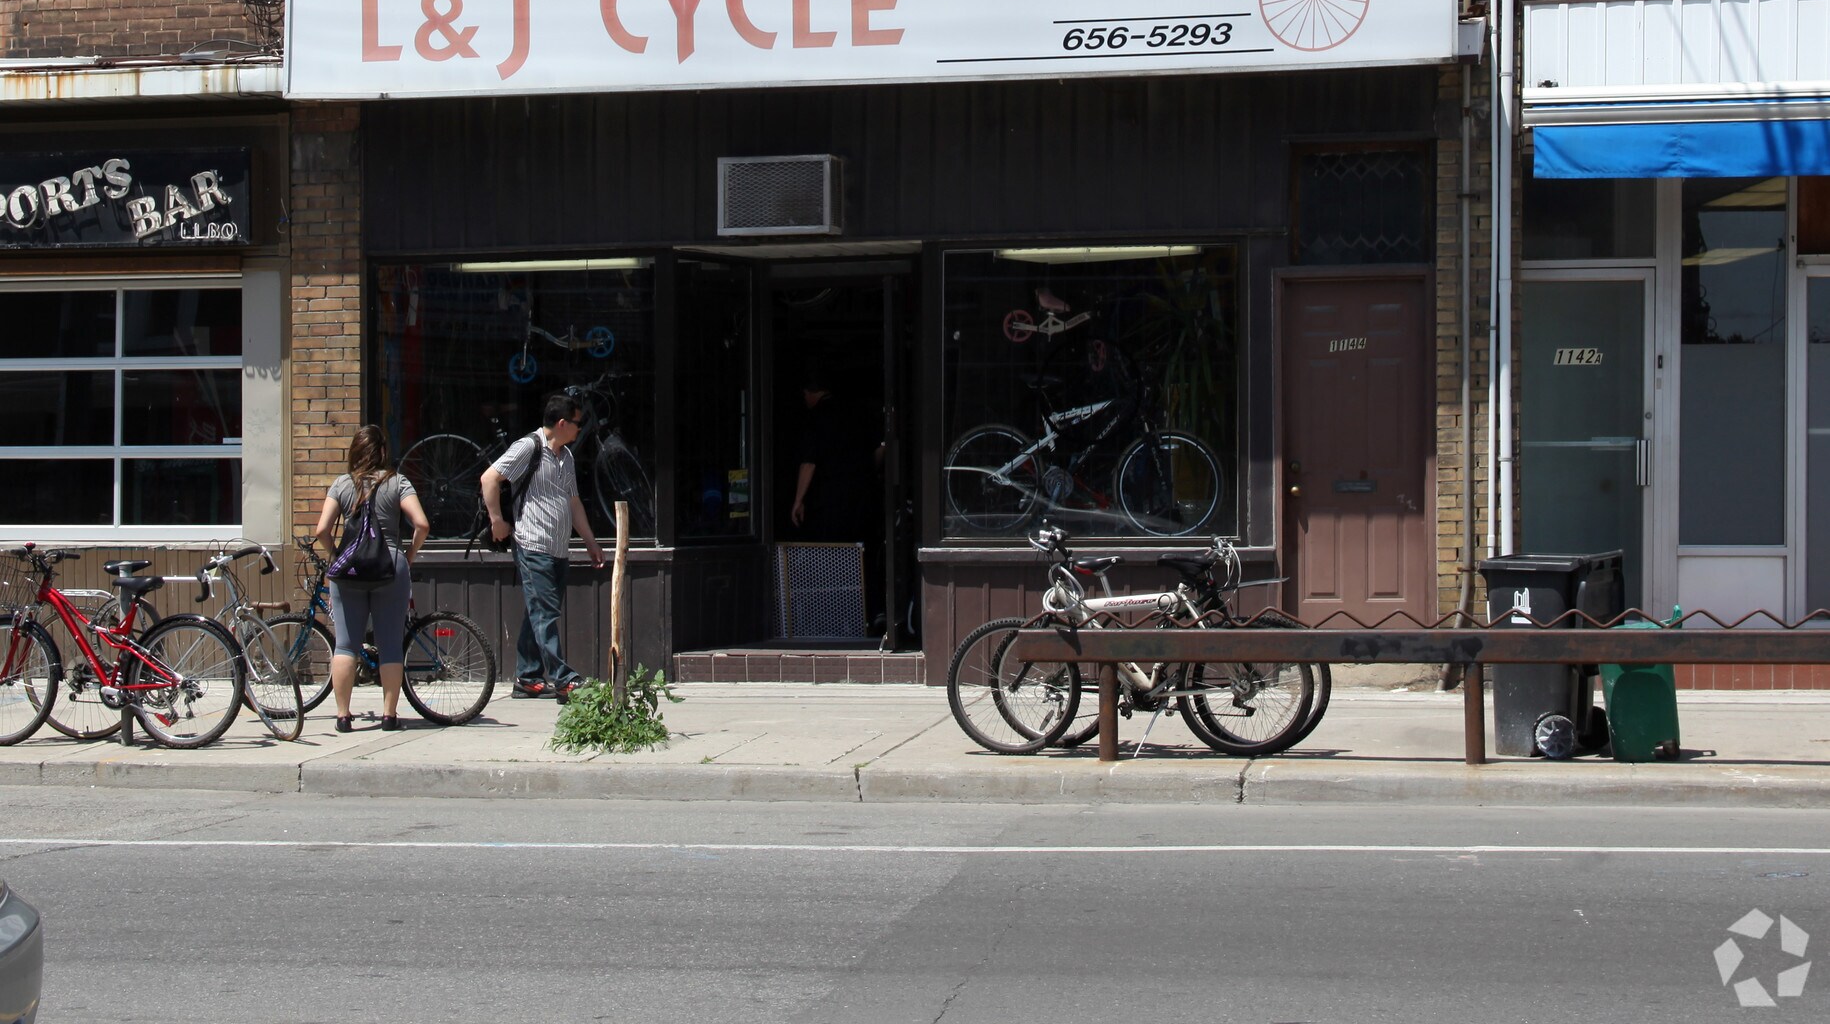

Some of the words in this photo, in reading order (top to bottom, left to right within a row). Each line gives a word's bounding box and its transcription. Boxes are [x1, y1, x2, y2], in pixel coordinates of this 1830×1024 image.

[1062, 22, 1233, 51] 656-5293
[0, 158, 132, 229] ORTS
[126, 169, 232, 238] BAR
[1329, 337, 1367, 352] 1144
[1556, 348, 1602, 365] 1142A
